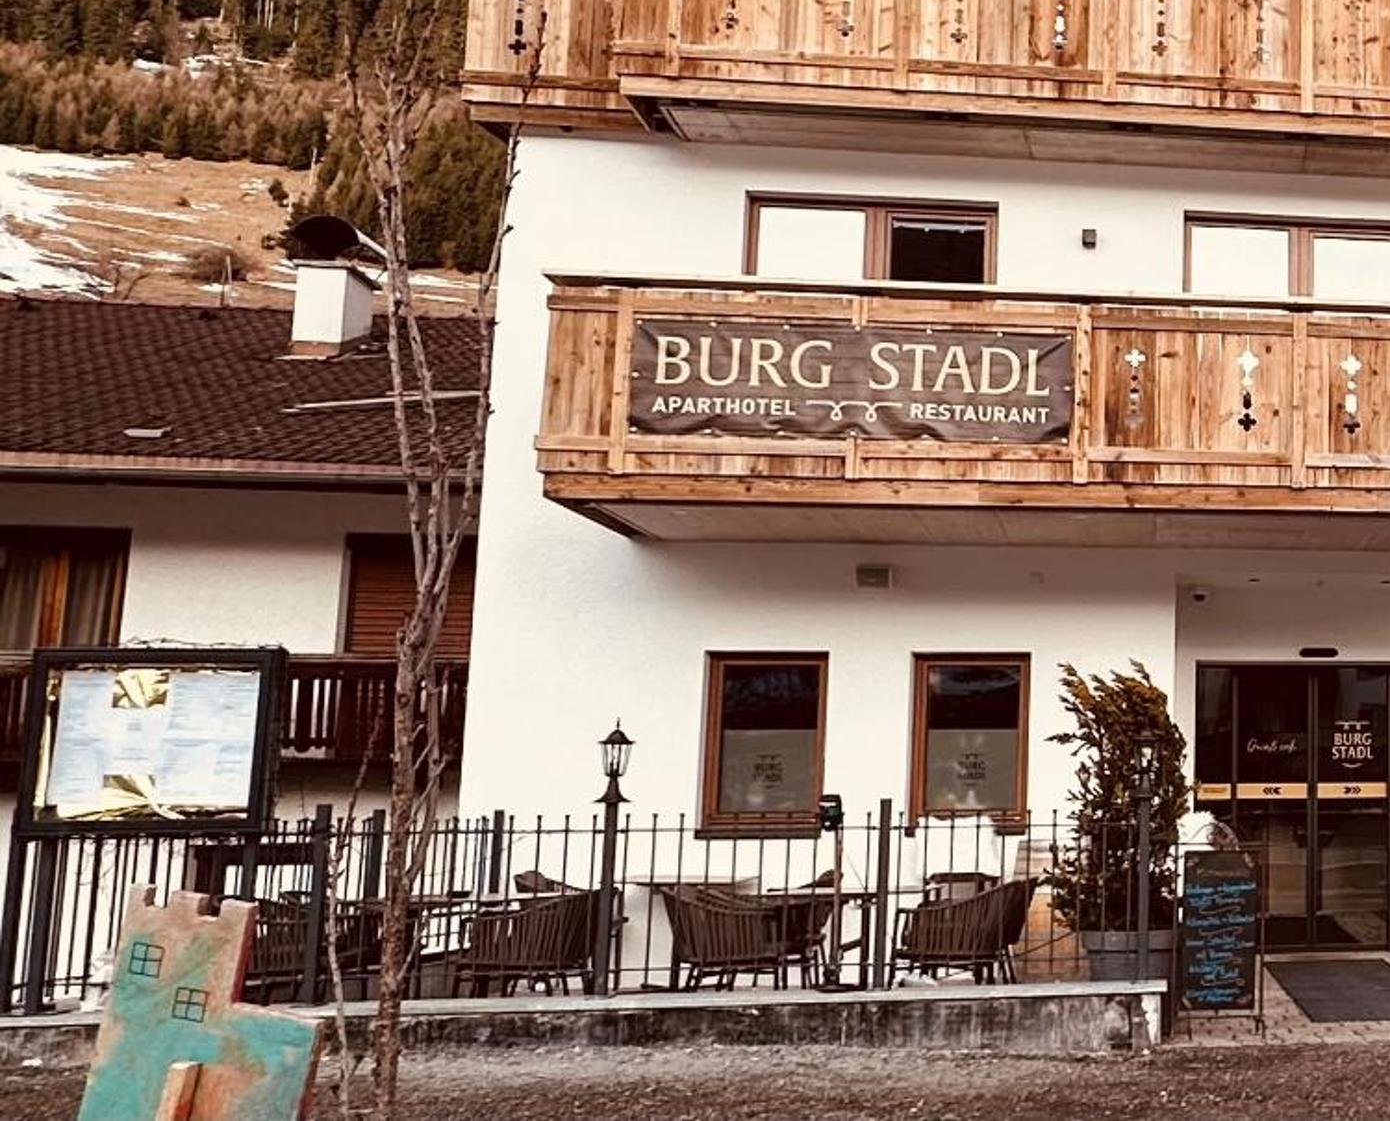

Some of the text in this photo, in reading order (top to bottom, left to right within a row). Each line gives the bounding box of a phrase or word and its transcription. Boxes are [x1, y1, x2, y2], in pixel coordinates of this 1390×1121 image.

[655, 336, 1050, 396] BURG STADL
[652, 396, 1050, 424] APARTHOTEL RESTAURANT
[1333, 732, 1372, 746] BURG
[1331, 746, 1374, 760] STADL
